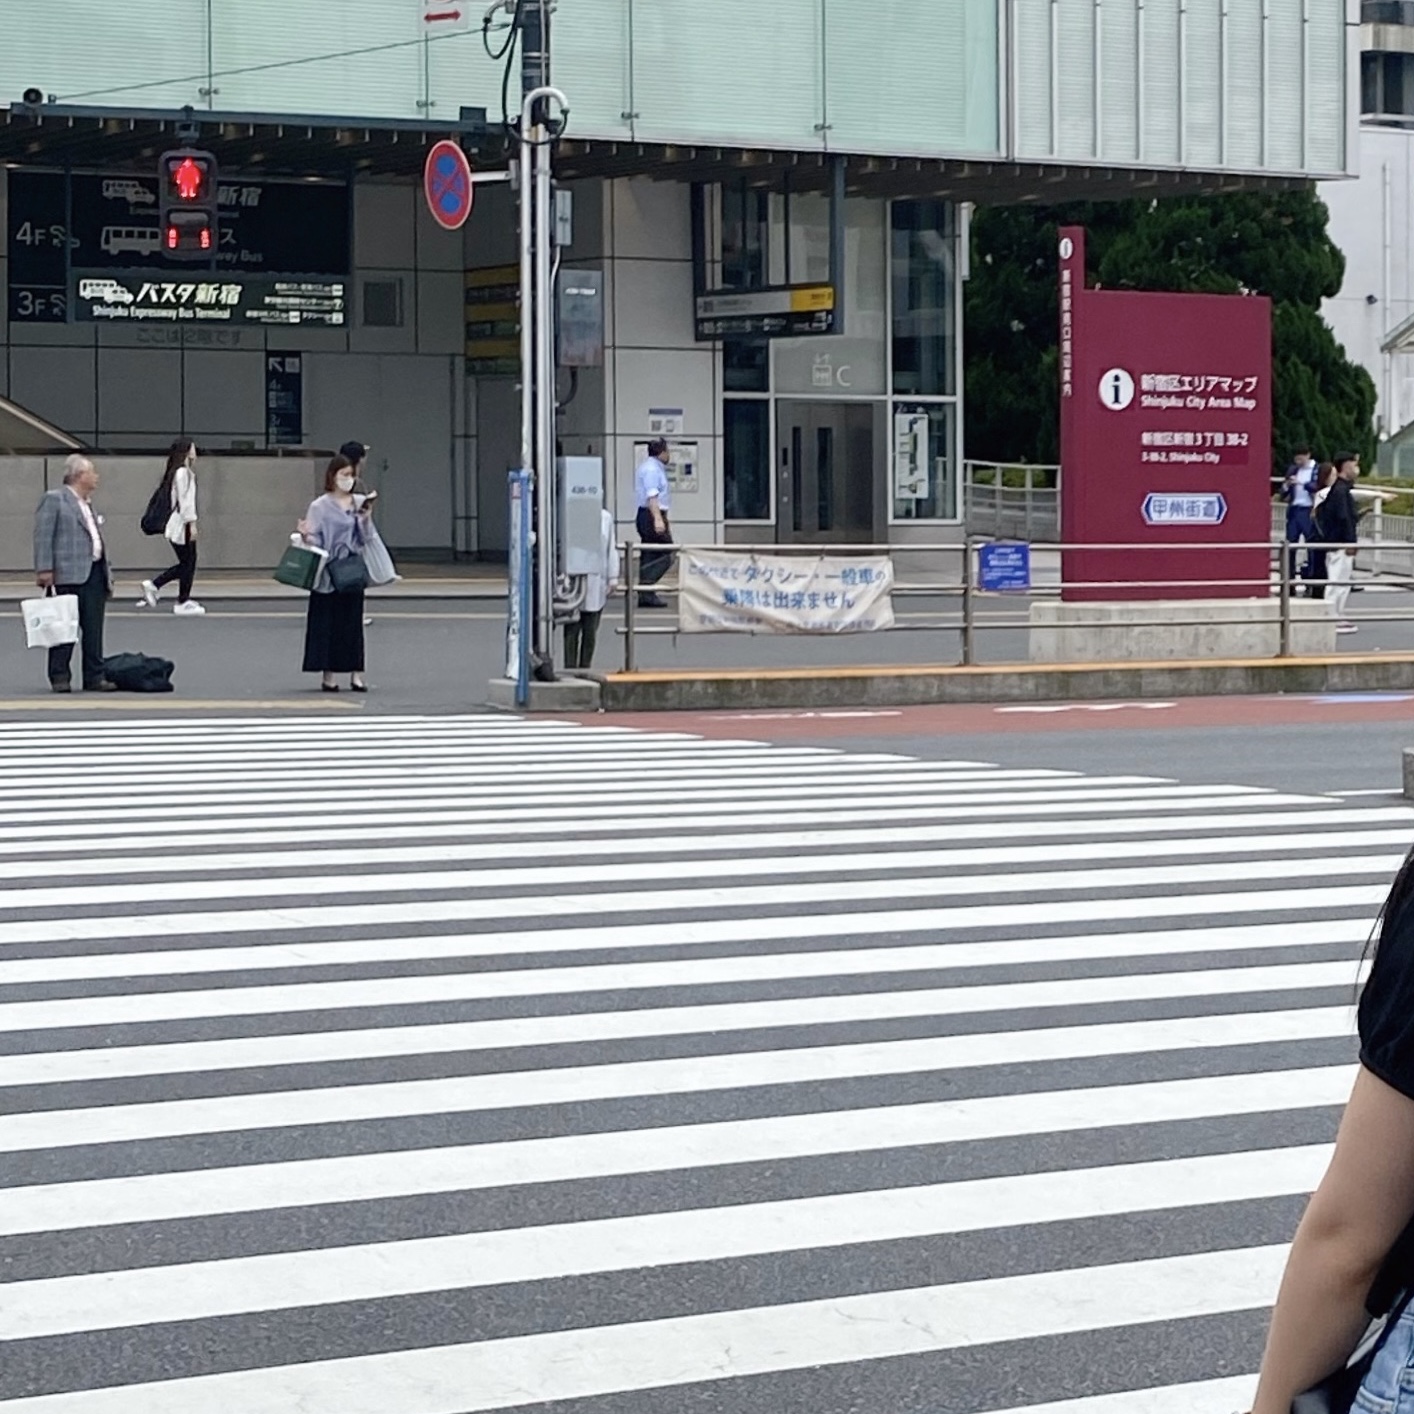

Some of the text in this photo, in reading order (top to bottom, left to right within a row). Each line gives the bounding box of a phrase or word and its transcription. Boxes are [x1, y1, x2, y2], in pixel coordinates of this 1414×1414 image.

[15, 221, 47, 246] 4F
[17, 291, 47, 316] 3F
[136, 283, 242, 305] バスタ新宿
[93, 305, 129, 318] Shinjuku
[1141, 374, 1258, 393] 新宿区エリアマップ
[1141, 394, 1257, 411] Shinjuku City Area Map
[1153, 499, 1217, 518] 甲州街道
